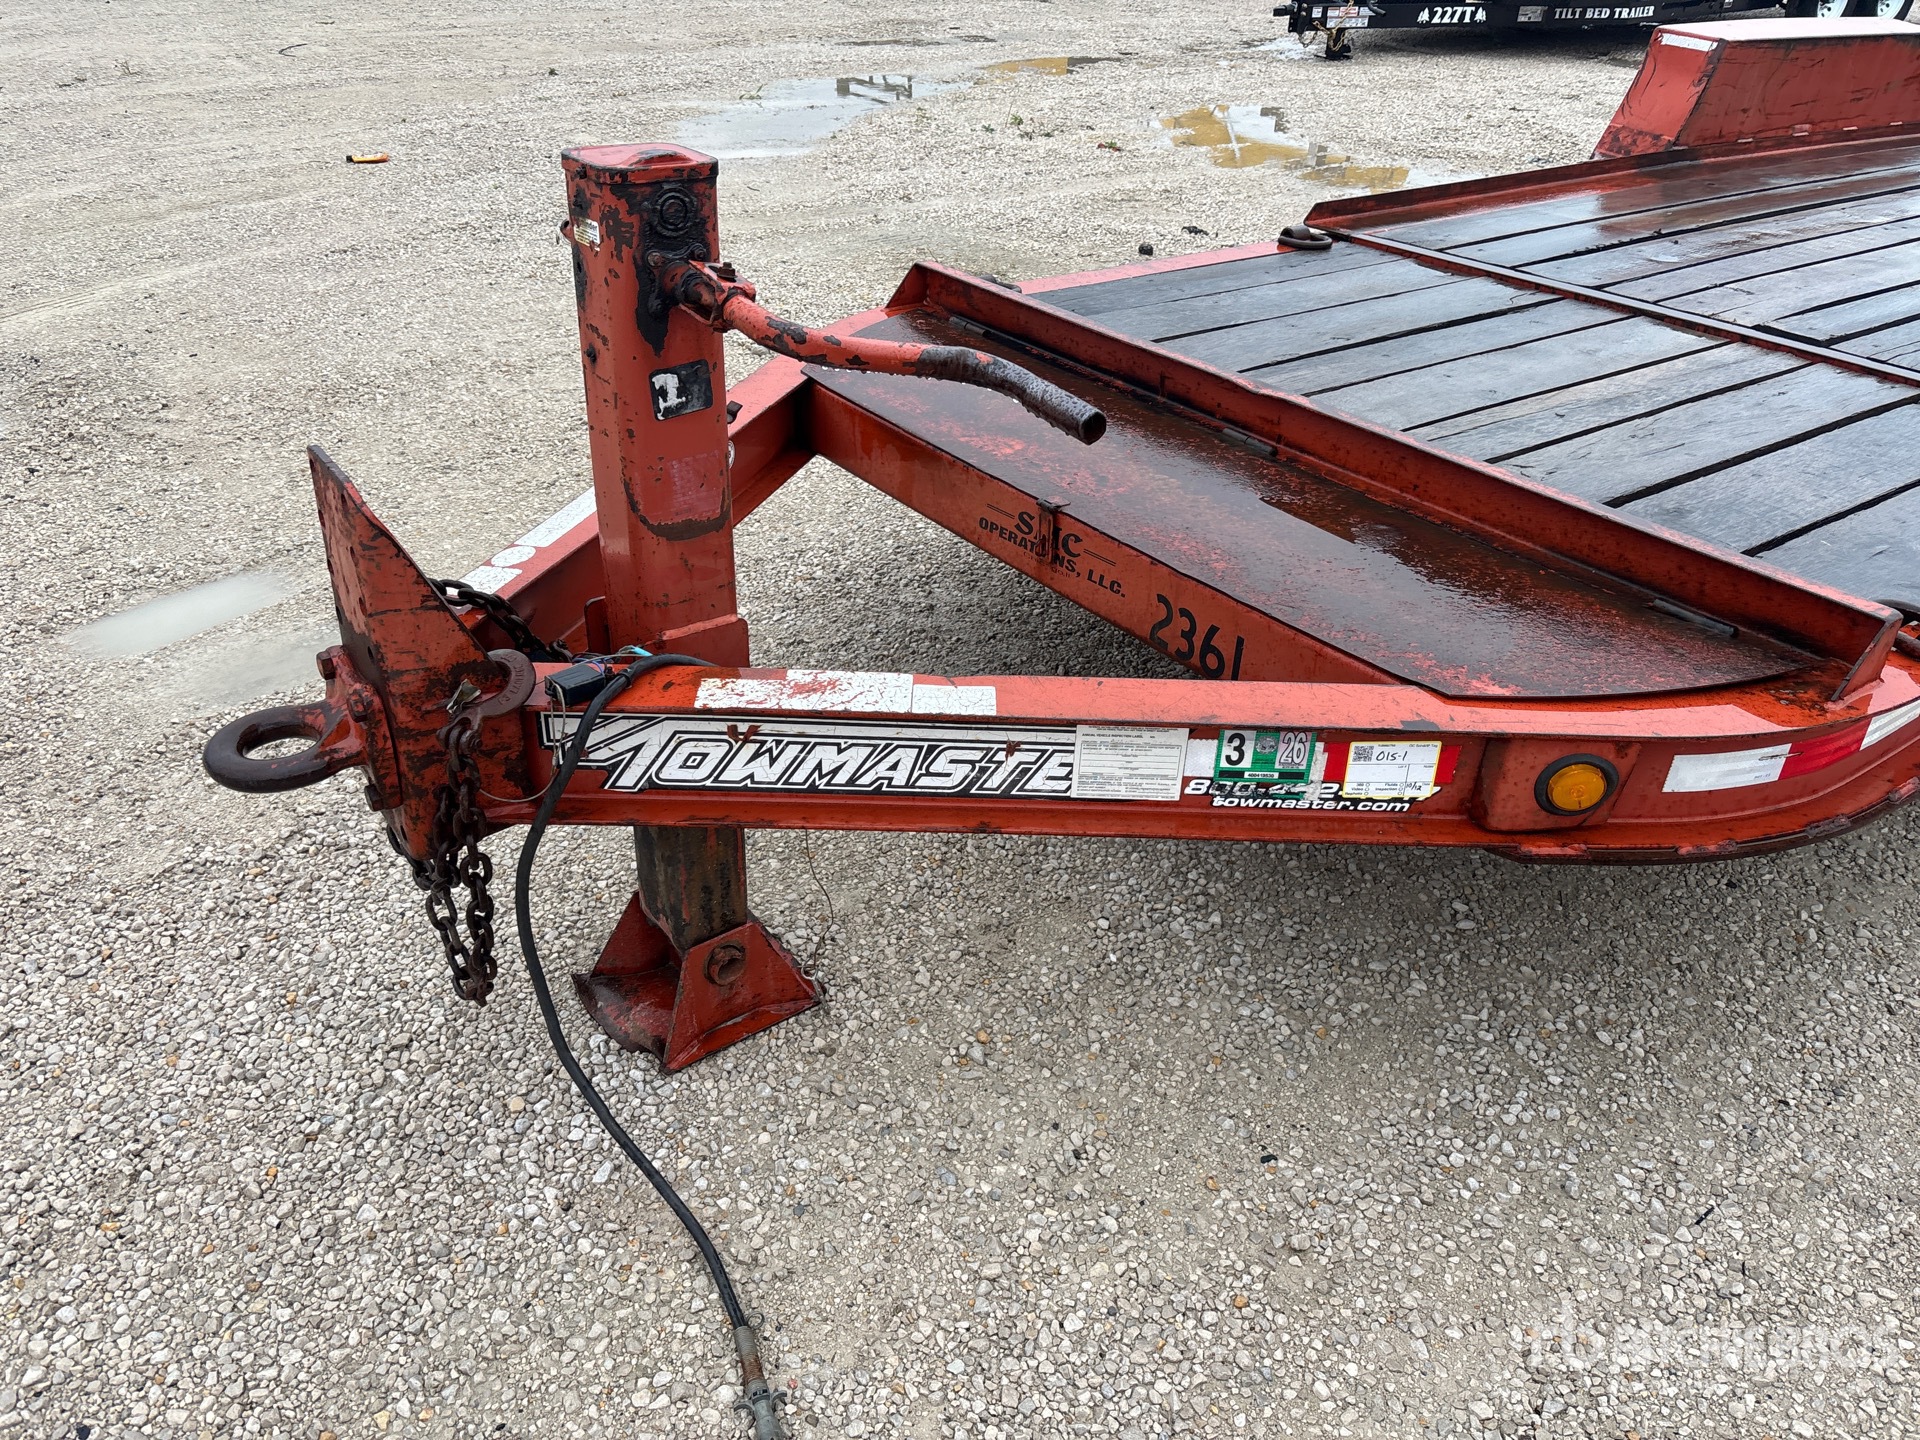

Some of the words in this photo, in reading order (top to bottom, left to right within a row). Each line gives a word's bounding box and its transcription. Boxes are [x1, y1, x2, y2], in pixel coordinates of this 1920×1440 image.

[1431, 7, 1475, 24] 227T
[1554, 8, 1582, 19] TILT
[1585, 8, 1610, 19] BED
[1613, 6, 1655, 19] TRAILER
[979, 517, 1082, 577] OPERATNS,
[1087, 568, 1126, 598] LLC.
[1149, 594, 1245, 681] 2361
[544, 713, 1075, 794] TOWMASTE
[1225, 733, 1246, 766] 3
[1279, 730, 1308, 765] 26
[1212, 796, 1411, 812] towmaster.com
